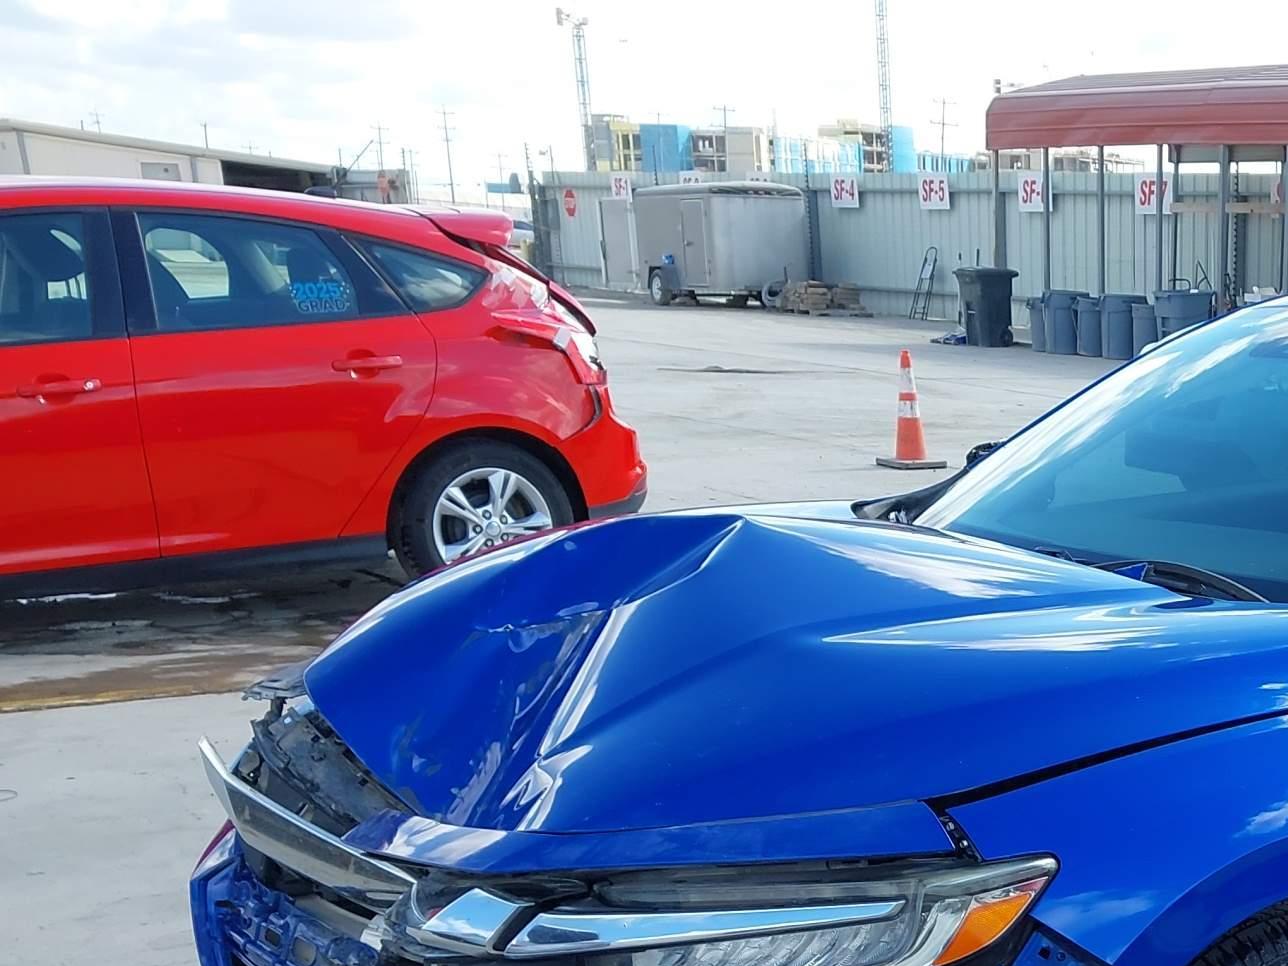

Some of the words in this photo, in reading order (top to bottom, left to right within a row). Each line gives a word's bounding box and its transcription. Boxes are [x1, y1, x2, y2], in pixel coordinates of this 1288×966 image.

[833, 179, 855, 200] SF-4
[921, 180, 945, 202] SF-5
[1140, 180, 1168, 206] SF7
[293, 282, 341, 299] 2025
[297, 297, 348, 313] GRAD
